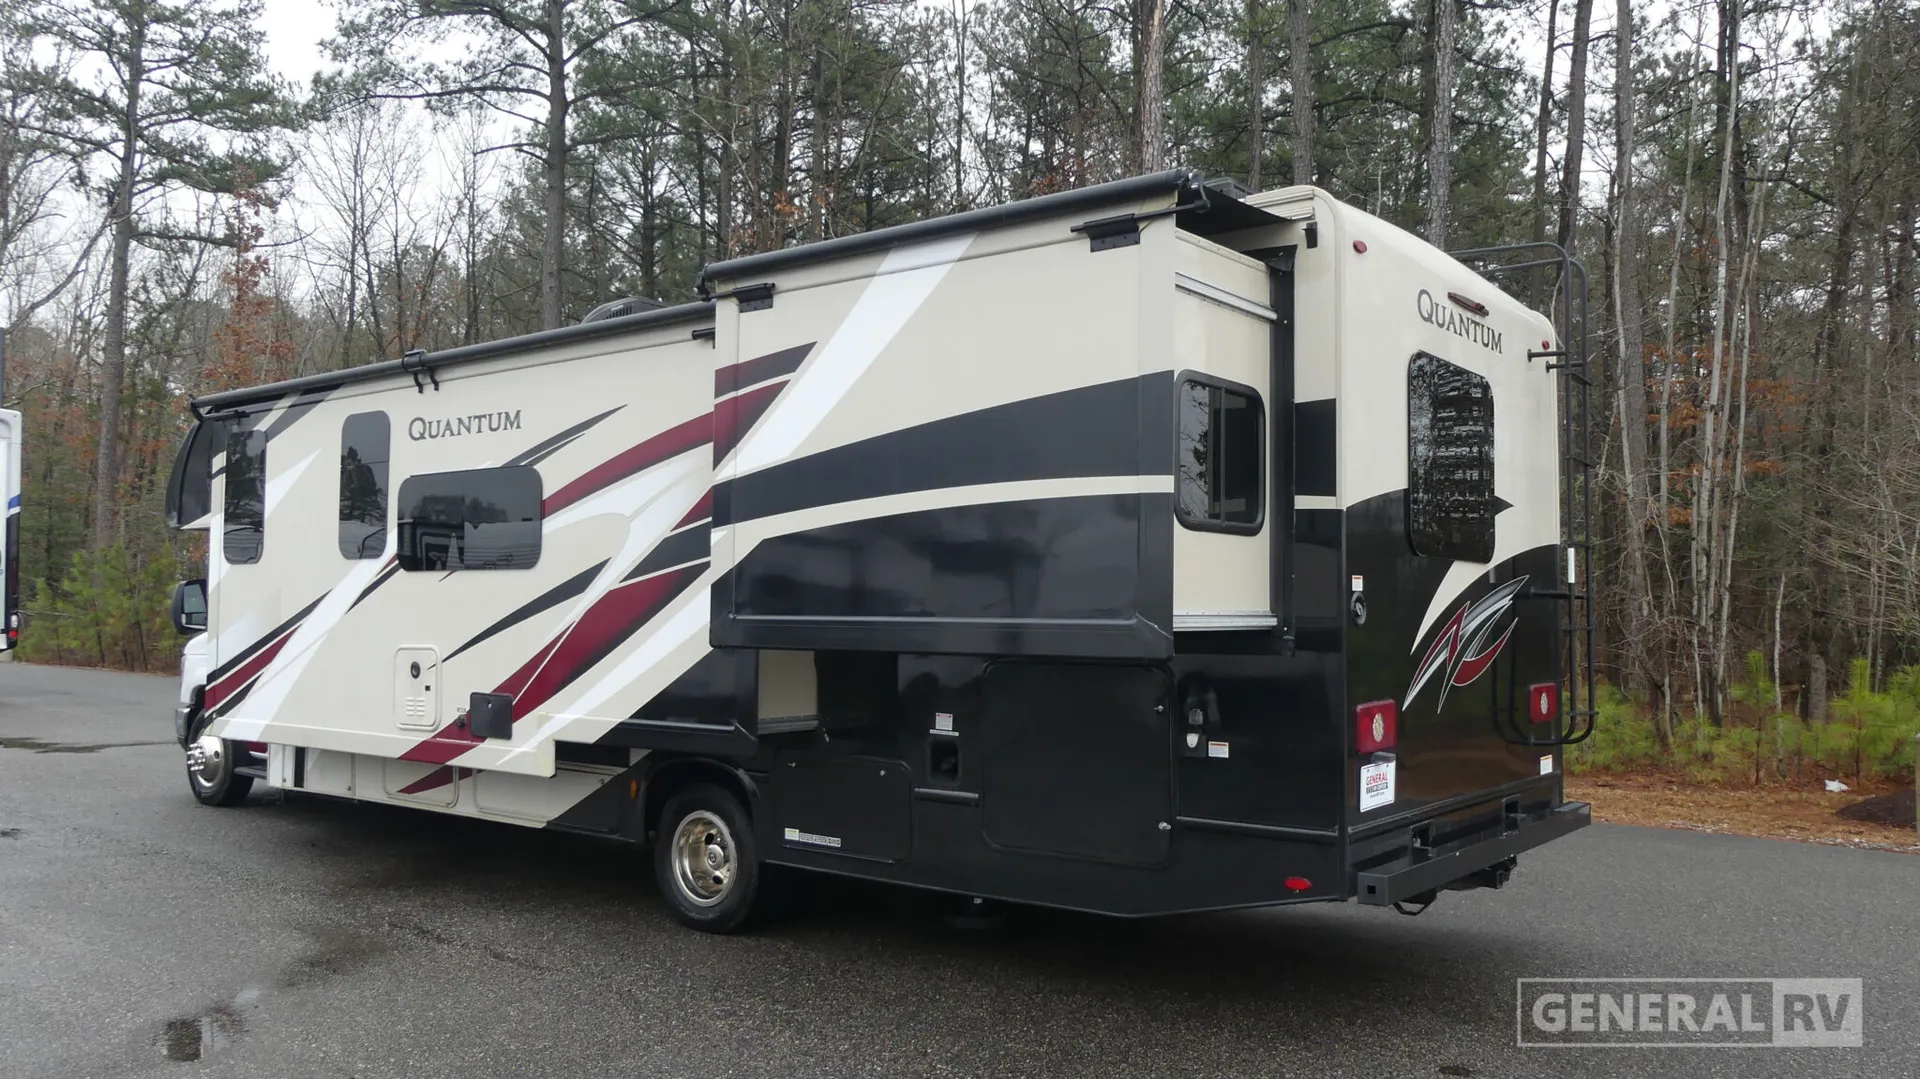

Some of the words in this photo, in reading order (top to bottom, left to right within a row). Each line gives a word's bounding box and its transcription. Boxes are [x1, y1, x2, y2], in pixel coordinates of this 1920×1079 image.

[1417, 288, 1502, 354] QUANTUM
[408, 409, 522, 441] QUANTUM
[1366, 772, 1388, 786] GENERAL
